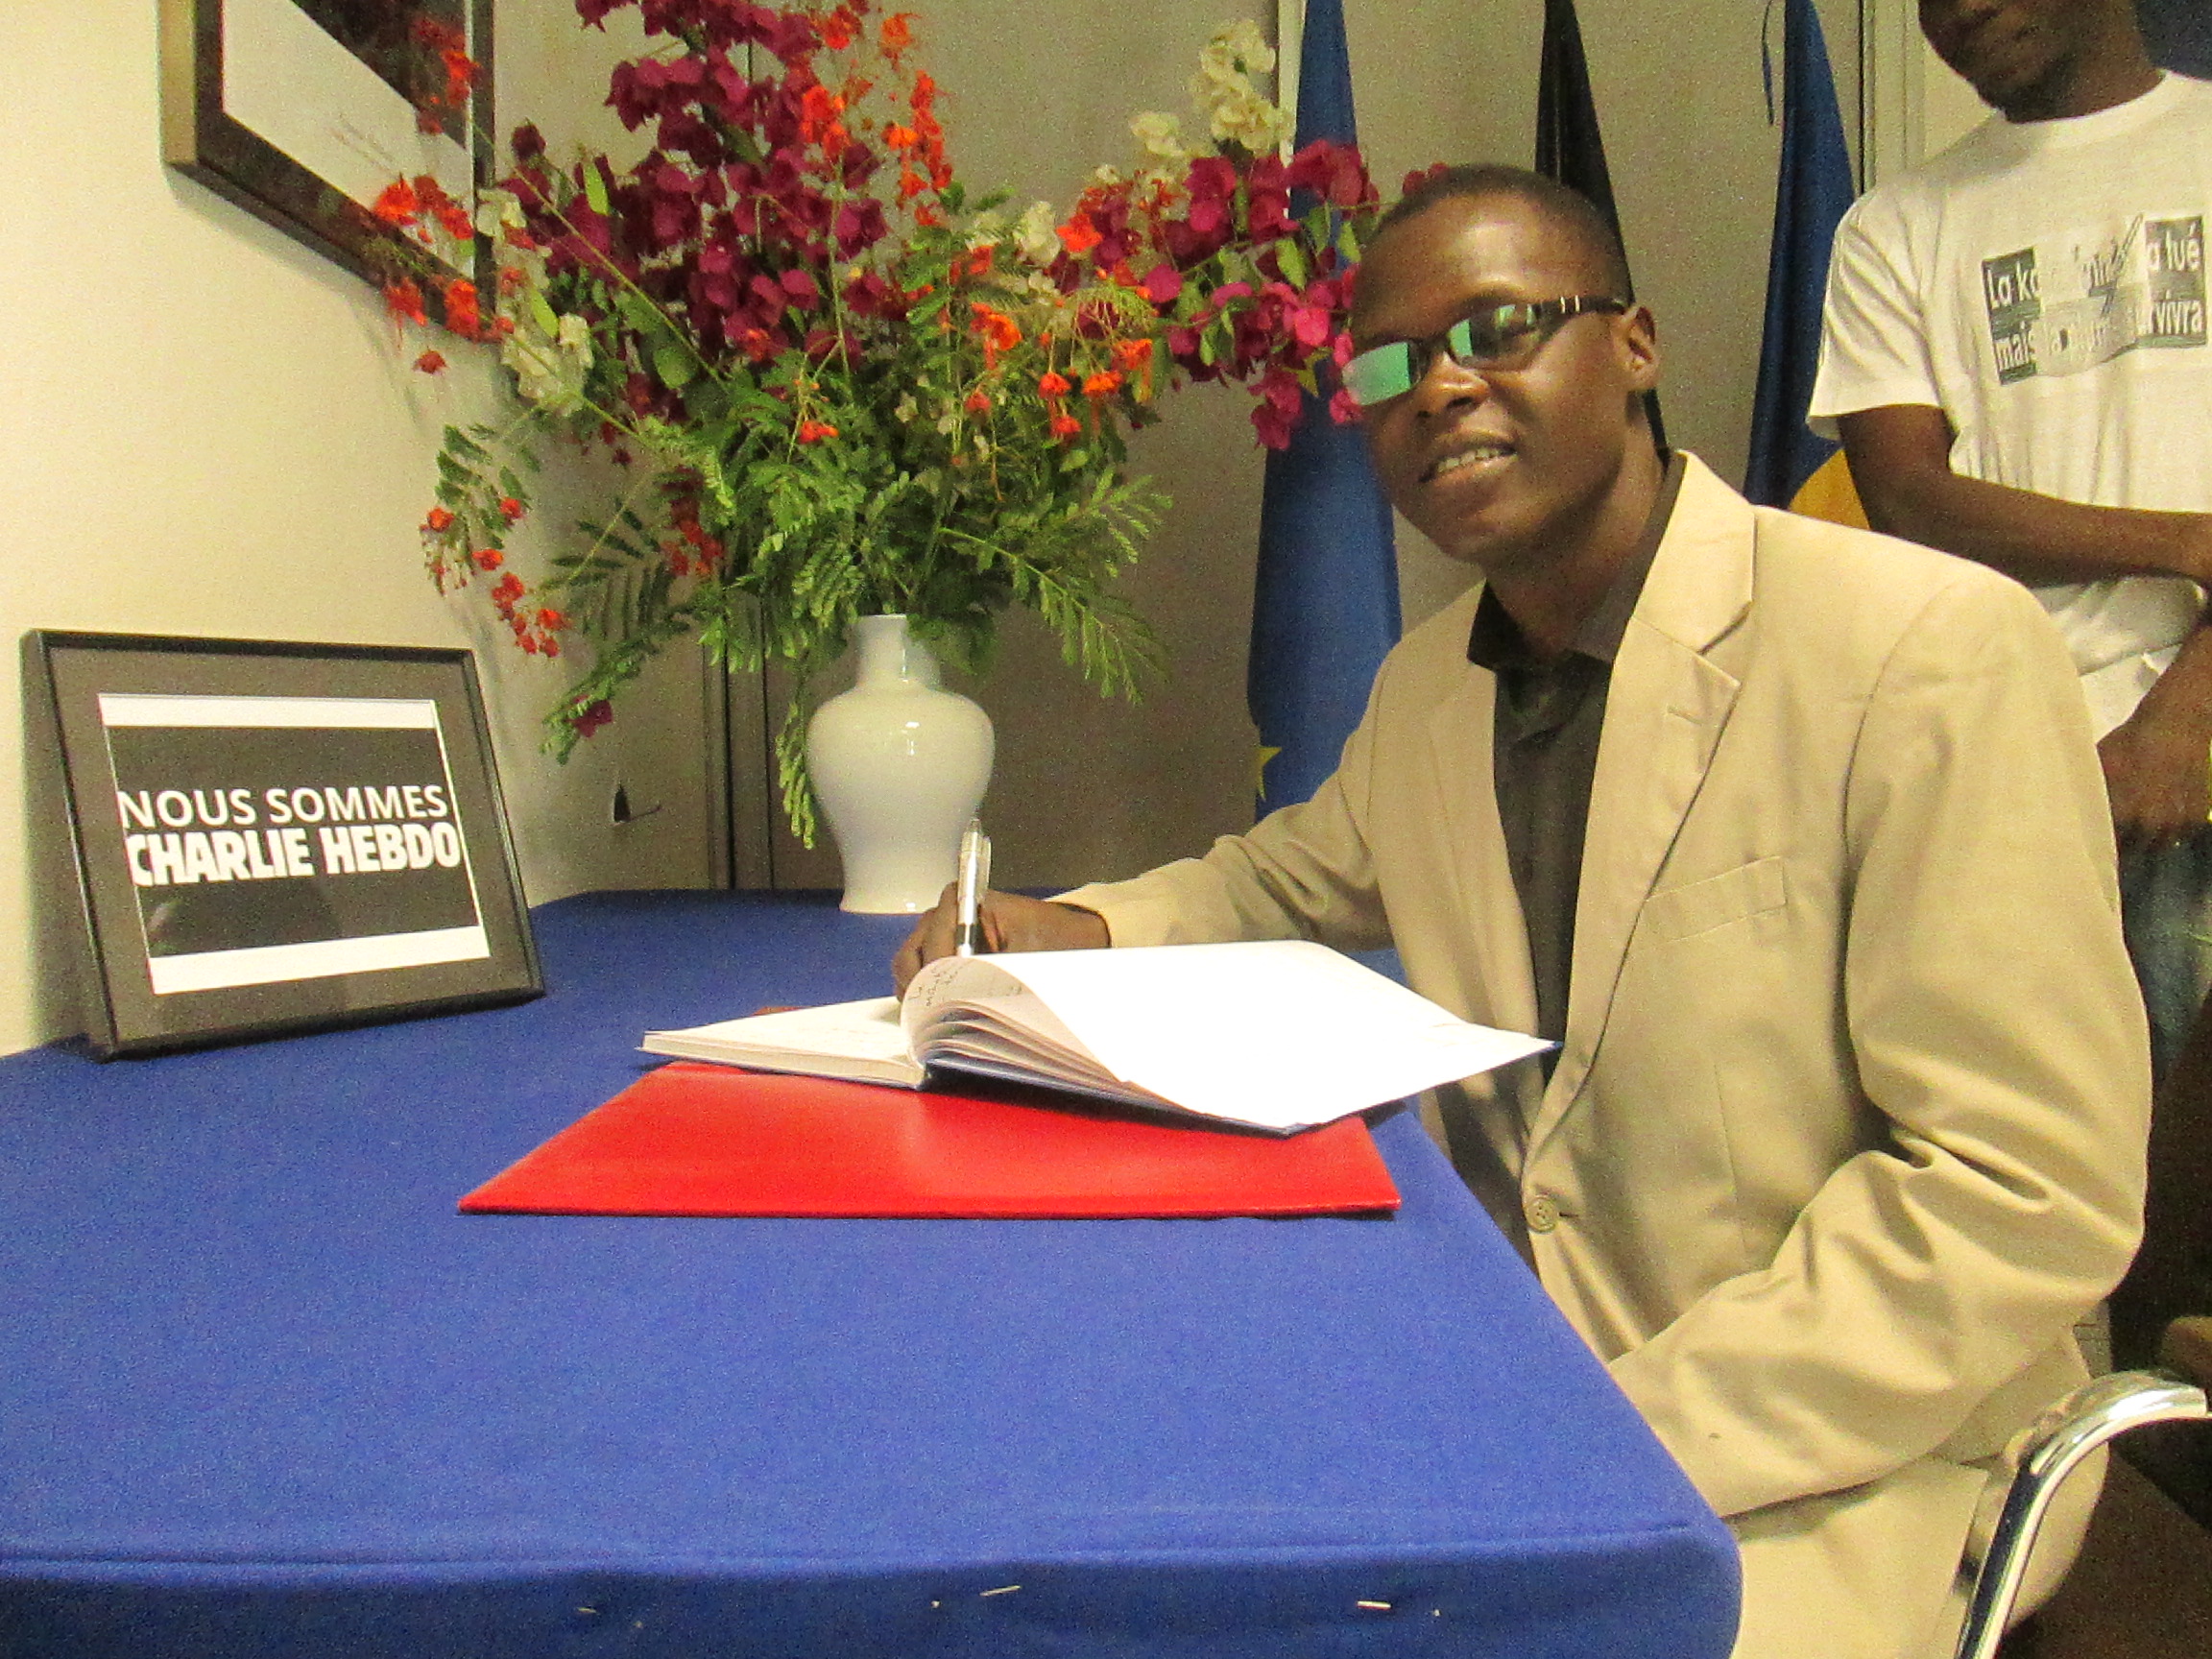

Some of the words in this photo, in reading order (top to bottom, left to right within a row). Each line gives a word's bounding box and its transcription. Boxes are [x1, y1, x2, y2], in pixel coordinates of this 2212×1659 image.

[2164, 222, 2202, 272] tué
[117, 788, 258, 829] NOUS
[266, 784, 447, 824] SOMMES
[126, 830, 316, 887] CHARLIE
[319, 821, 463, 876] HEBDO
